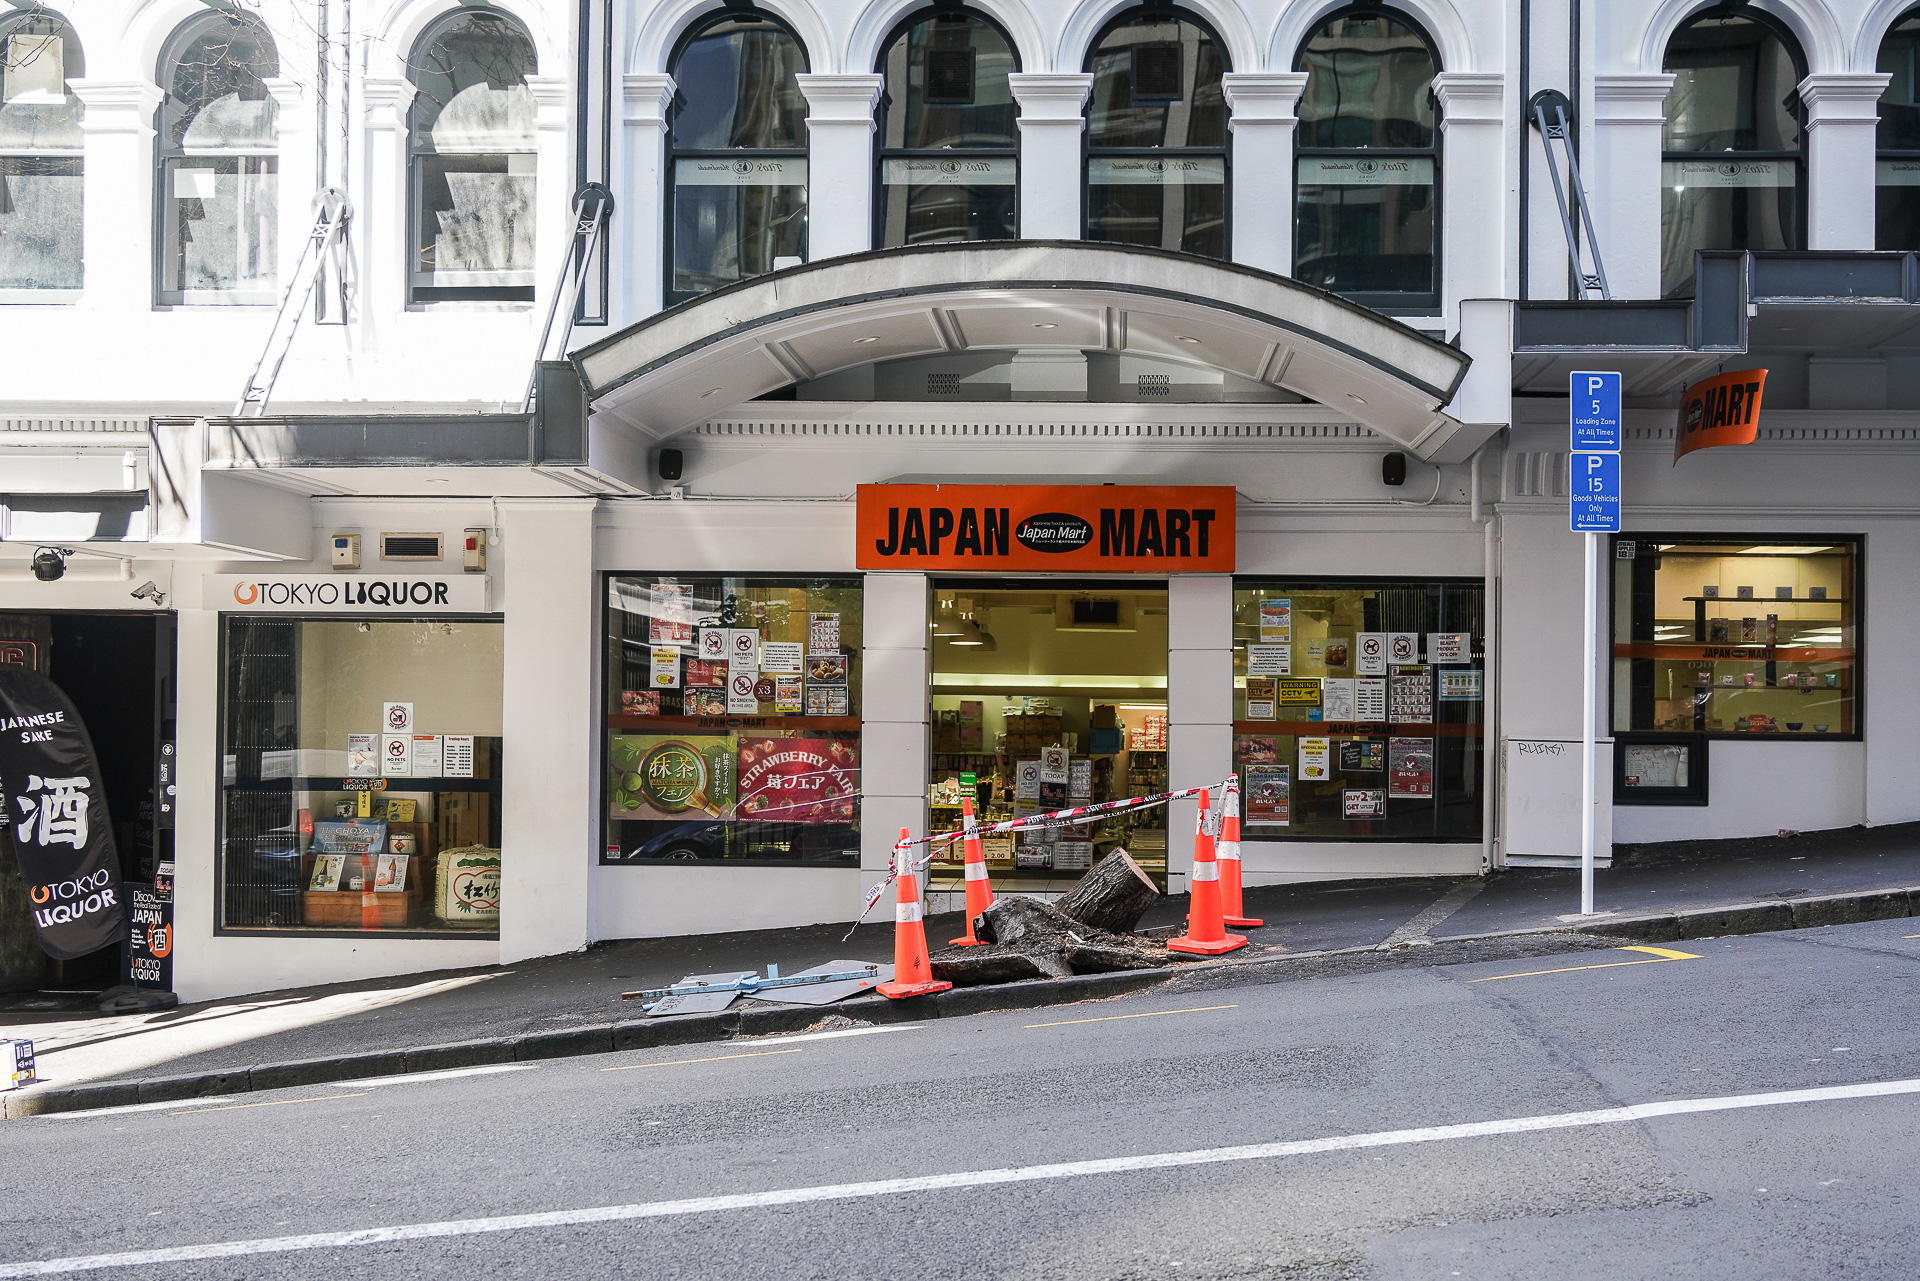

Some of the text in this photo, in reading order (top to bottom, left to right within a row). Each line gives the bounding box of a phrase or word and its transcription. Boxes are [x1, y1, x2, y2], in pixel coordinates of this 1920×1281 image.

[1588, 377, 1603, 395] P
[1592, 400, 1600, 414] 5
[1702, 382, 1760, 431] MART
[1588, 456, 1602, 474] P
[1588, 478, 1603, 492] 15
[1589, 504, 1602, 513] Only
[876, 507, 1215, 557] JAPAN MART
[1018, 525, 1087, 542] Japan Mart
[258, 582, 449, 606] TOKYO LIQUOR
[1702, 649, 1772, 659] JAPAN MART
[0, 711, 64, 731] JAPANESE
[698, 718, 766, 728] JAPAN MART
[21, 730, 54, 743] SAKE
[1327, 724, 1355, 734] JAPAN
[1373, 724, 1397, 735] MART
[1518, 742, 1566, 756] RUINS!
[650, 756, 696, 779] 抹茶
[740, 751, 854, 794] STRAWBERRY FAIR
[766, 774, 826, 790] 苺フェア
[656, 786, 688, 798] フェア
[1360, 792, 1368, 801] 2
[17, 774, 90, 849] 酒
[48, 869, 109, 900] TOKYO
[464, 880, 500, 900] 松竹
[35, 888, 117, 928] LIQUOR
[132, 909, 162, 925] JAPAN
[138, 957, 160, 970] TOKYO
